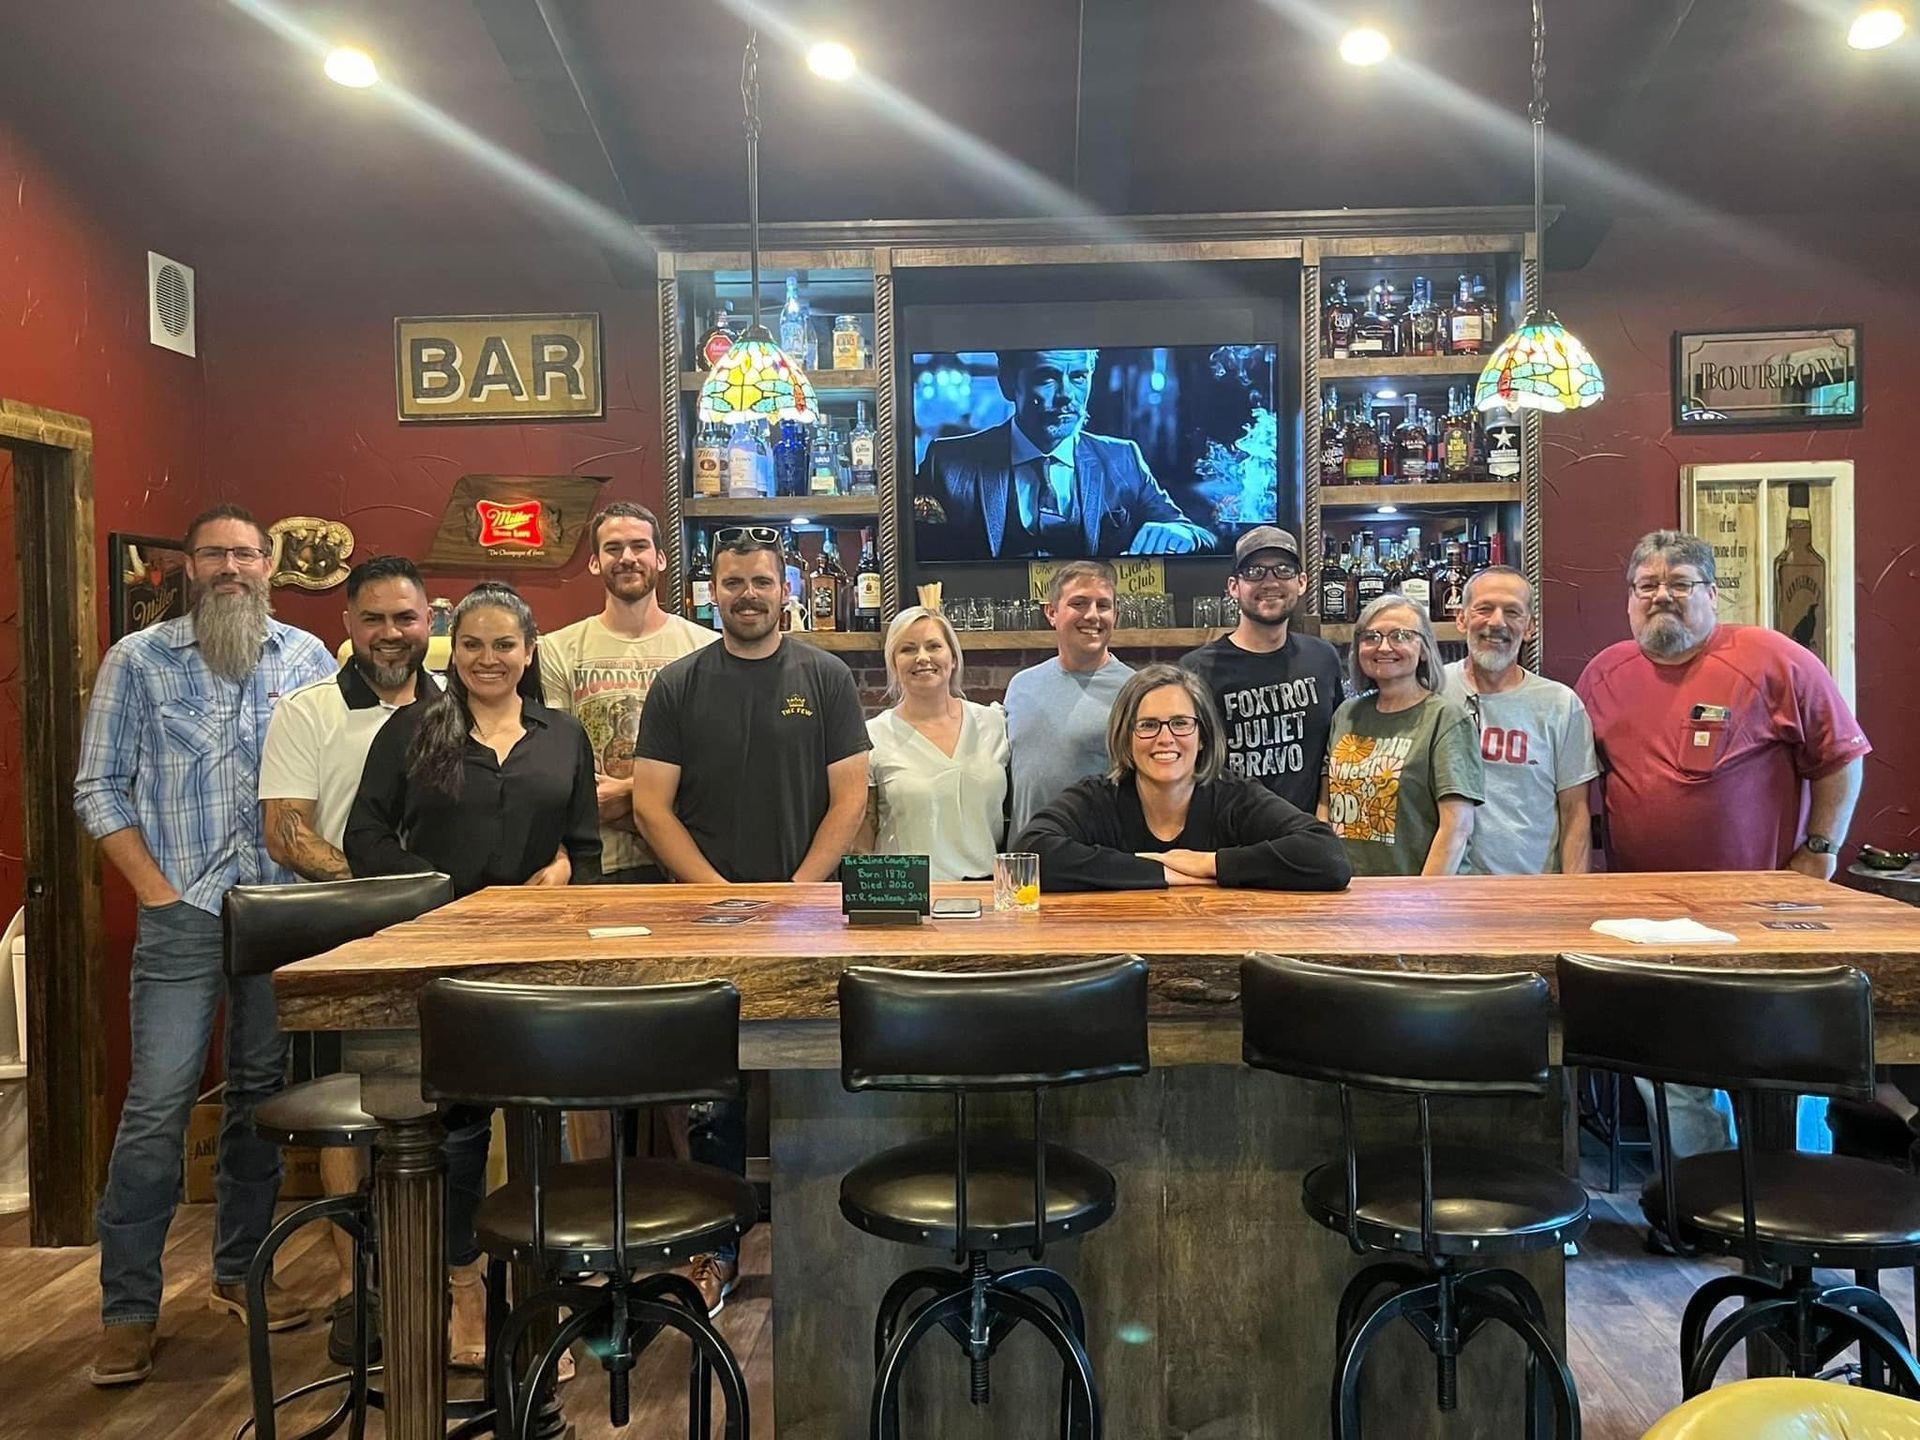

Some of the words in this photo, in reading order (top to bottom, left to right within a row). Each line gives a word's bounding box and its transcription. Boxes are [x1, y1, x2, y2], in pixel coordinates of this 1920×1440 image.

[410, 334, 587, 404] BAR
[1700, 357, 1837, 391] BOURBON
[486, 508, 535, 527] Miller
[1128, 570, 1156, 594] Club
[133, 588, 178, 630] Miller
[1223, 676, 1319, 721] FOXTROT
[1227, 710, 1306, 750] JULIET
[1228, 743, 1304, 780] BRAVO
[888, 880, 915, 890] 2020
